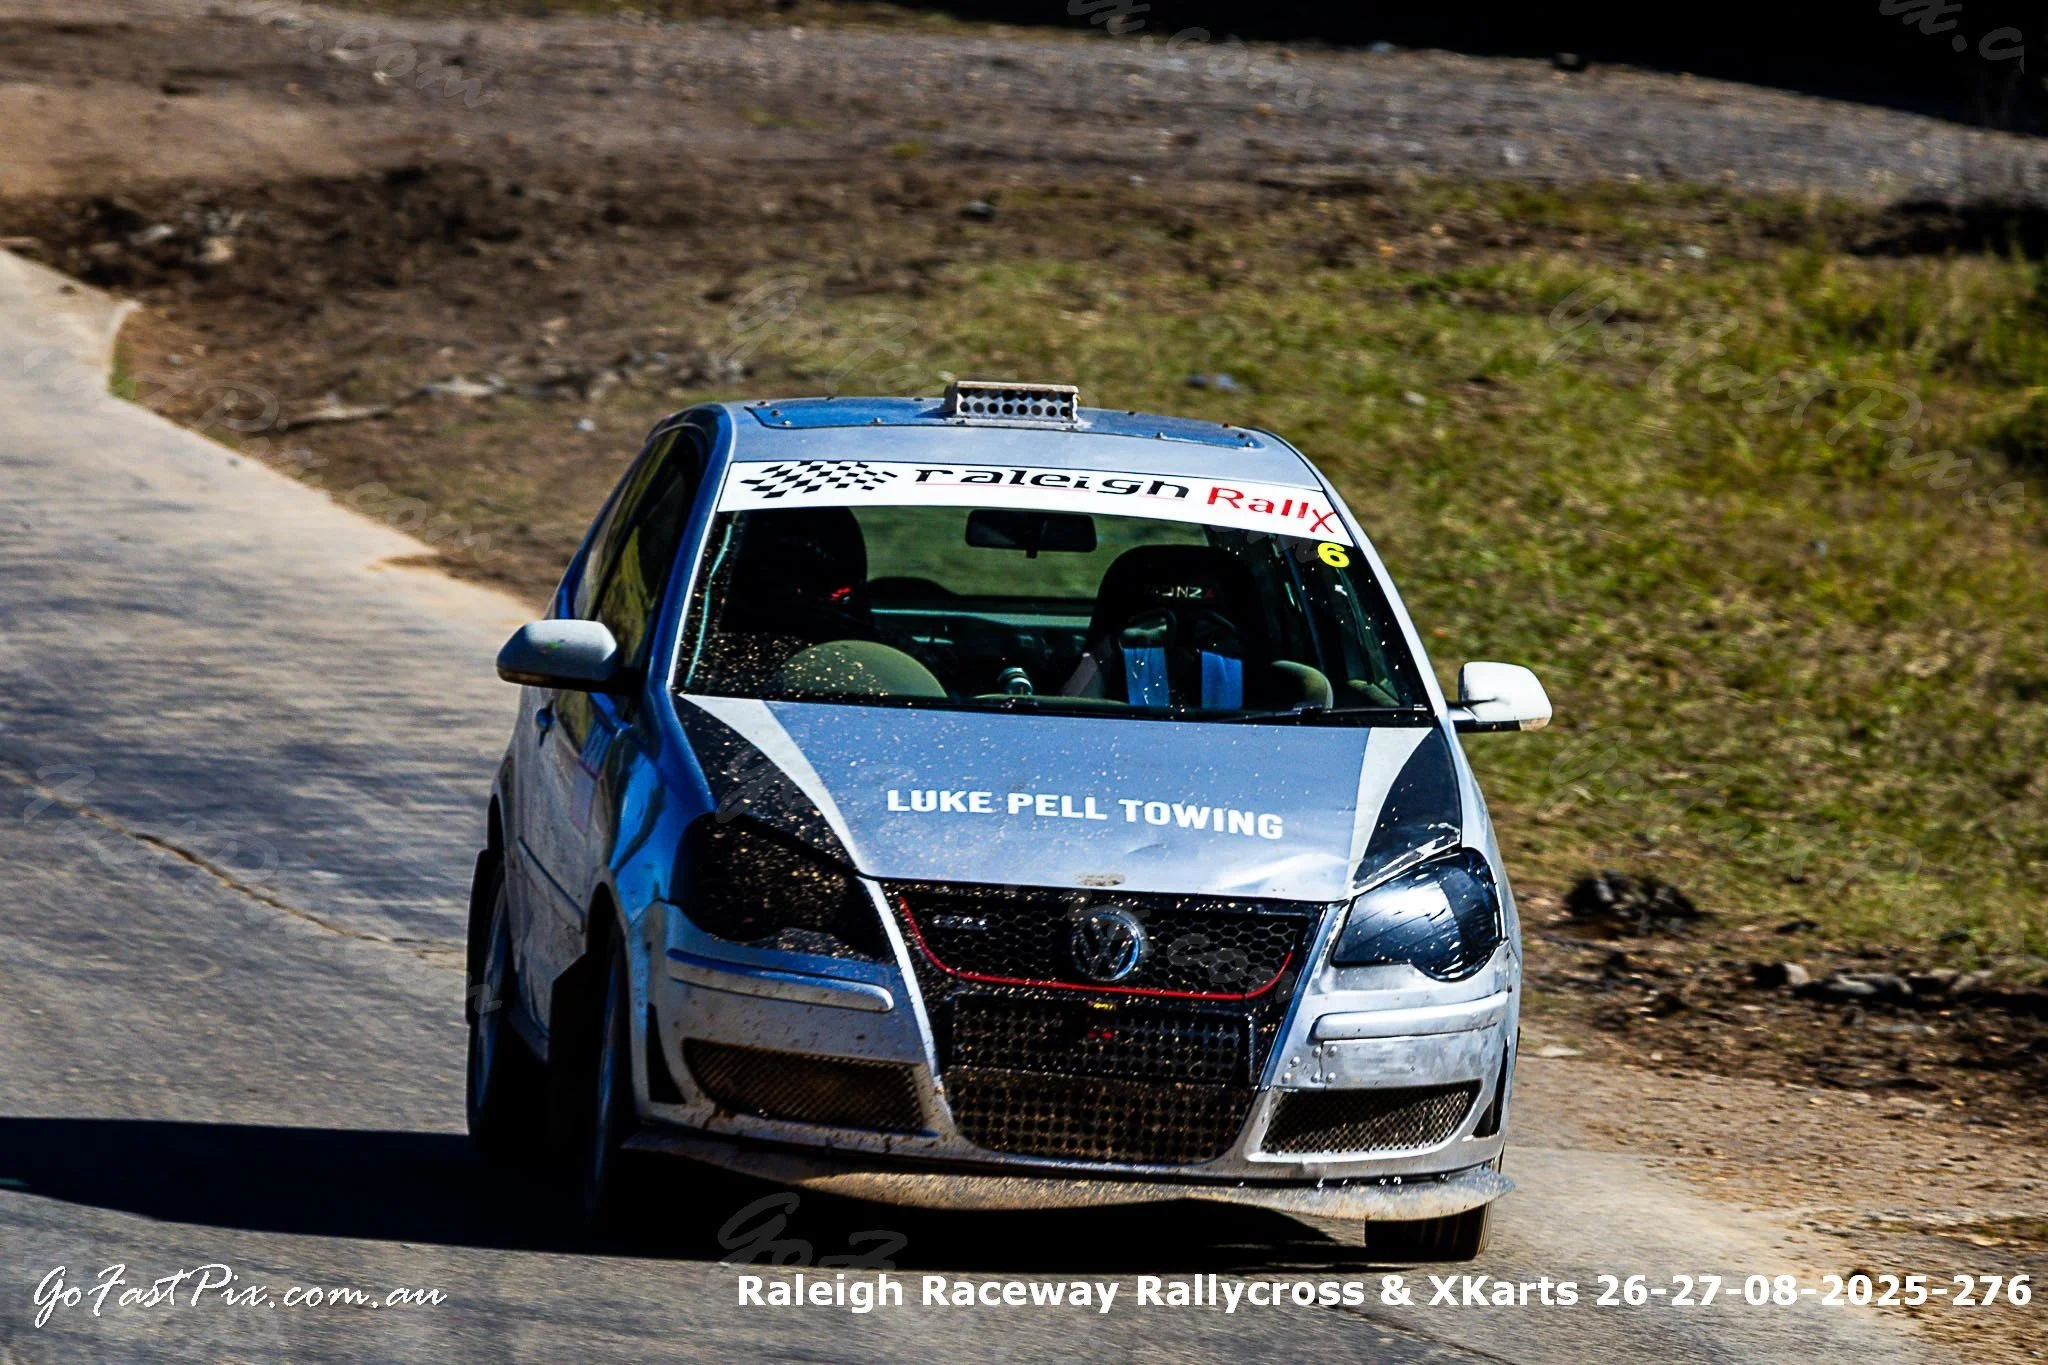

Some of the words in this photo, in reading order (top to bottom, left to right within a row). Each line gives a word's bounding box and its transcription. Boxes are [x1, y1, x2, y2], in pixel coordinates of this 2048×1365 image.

[914, 468, 1190, 499] raleigh
[1317, 542, 1350, 568] 6
[887, 789, 993, 813] LUKE
[1007, 792, 1108, 820] PELL
[1118, 798, 1284, 840] TOWING
